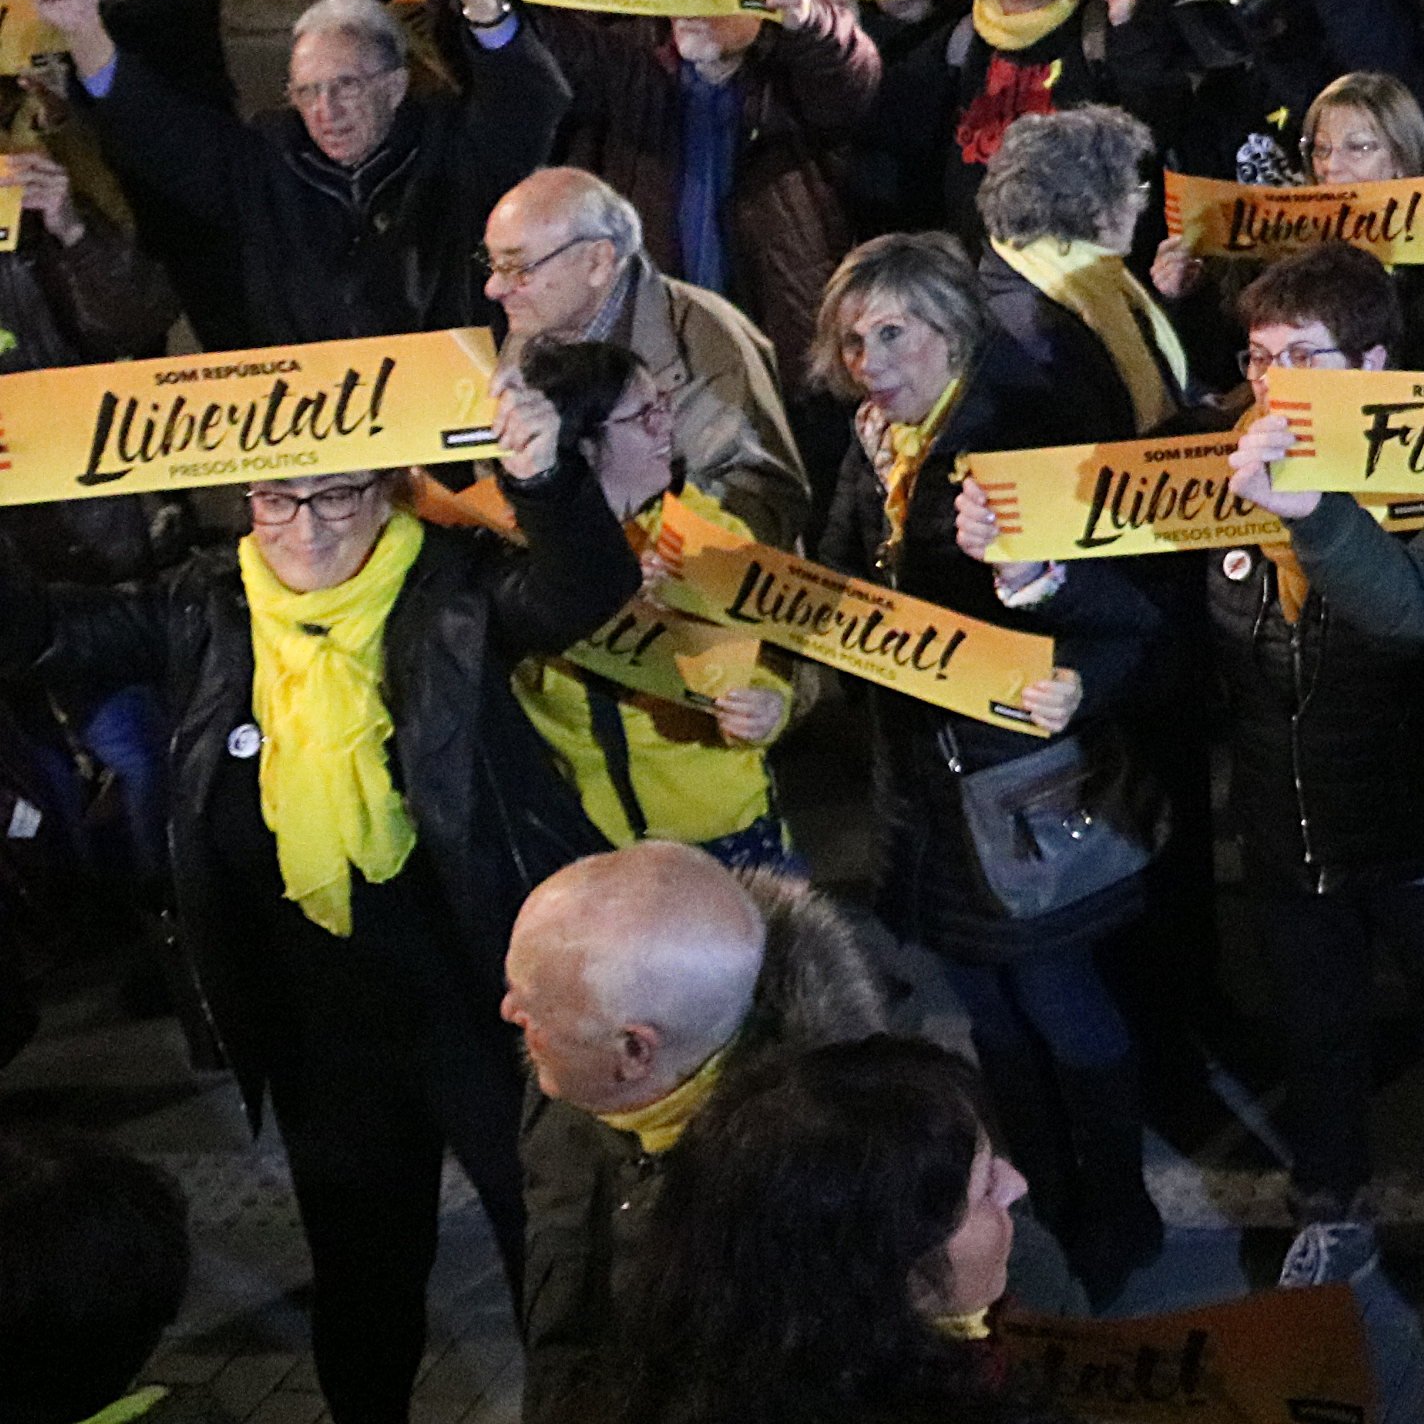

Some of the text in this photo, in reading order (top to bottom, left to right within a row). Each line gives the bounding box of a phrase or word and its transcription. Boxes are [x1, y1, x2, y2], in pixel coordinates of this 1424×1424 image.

[154, 359, 302, 387] SOM REPÚBLICA
[78, 358, 396, 485] Llibertat!
[1144, 448, 1184, 463] SOM
[169, 460, 238, 480] PRESOS
[727, 562, 966, 671] Llibertat!
